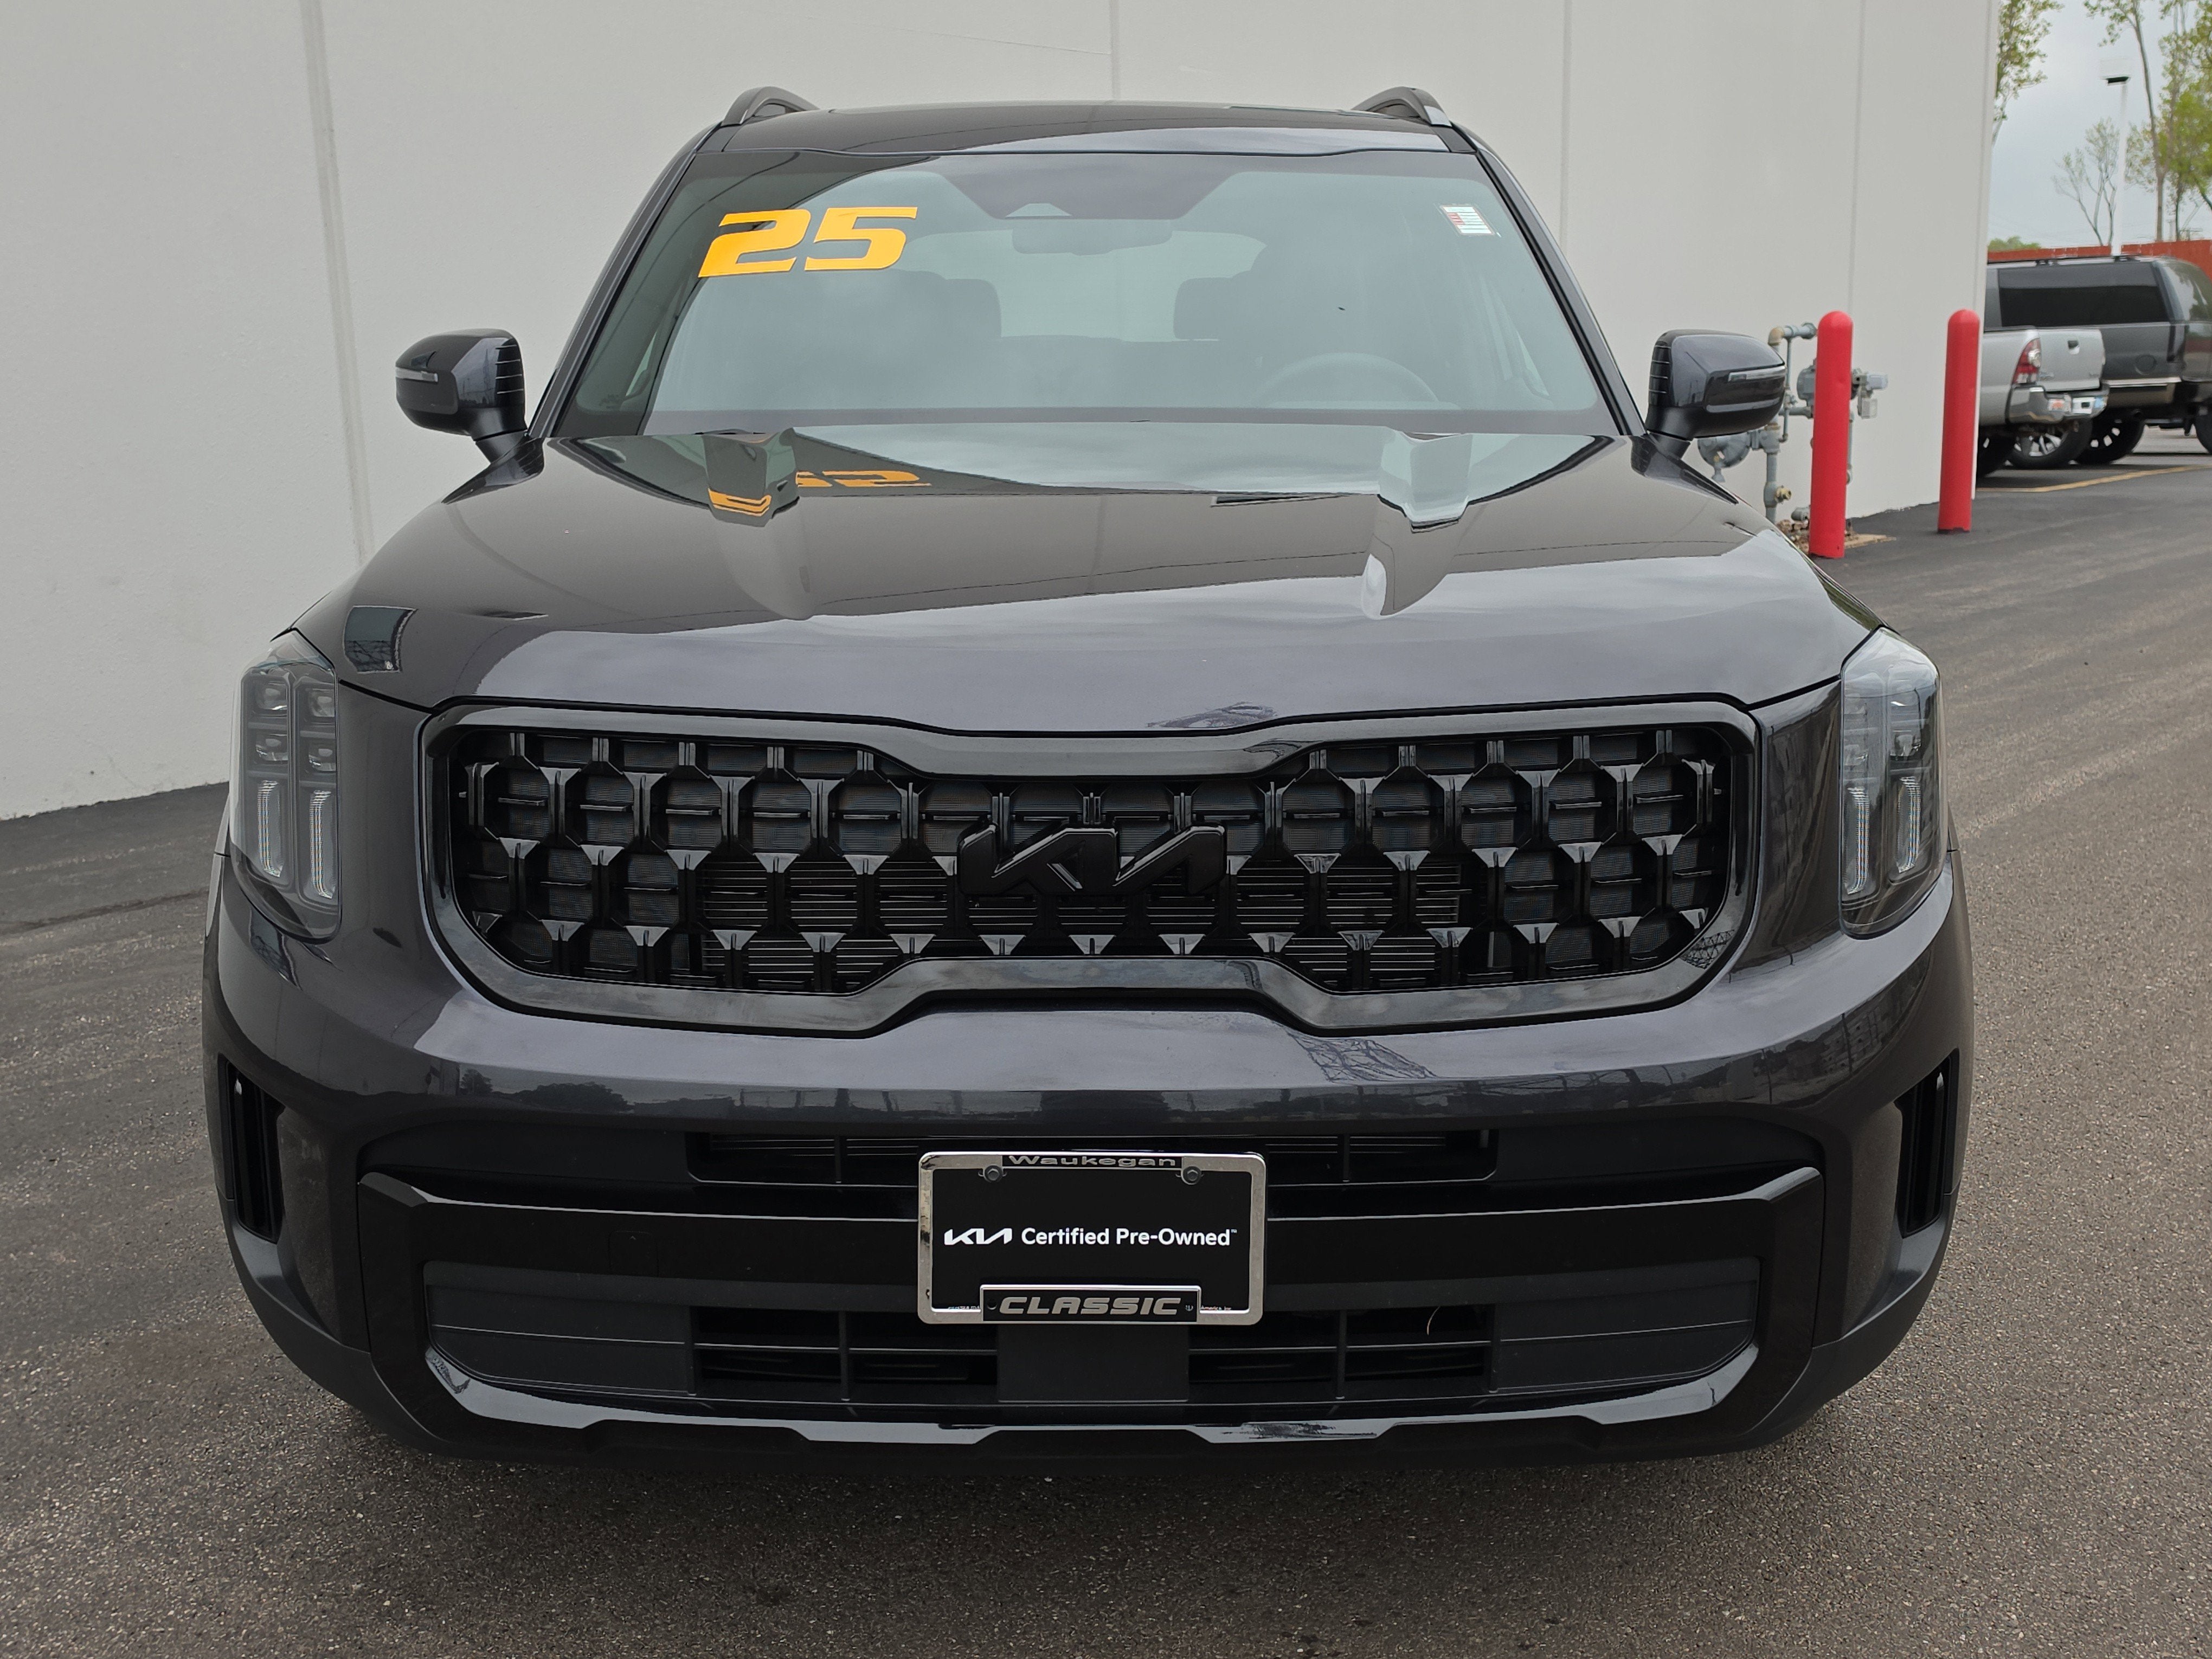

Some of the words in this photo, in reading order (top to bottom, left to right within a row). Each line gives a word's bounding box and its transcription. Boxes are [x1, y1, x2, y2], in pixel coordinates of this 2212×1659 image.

[698, 207, 918, 278] 25
[958, 824, 1227, 895] KIA
[1008, 1155, 1175, 1167] Waukegan
[944, 1228, 1013, 1245] KIA
[1021, 1227, 1109, 1245] Certified
[999, 1297, 1181, 1315] CLASSIC
